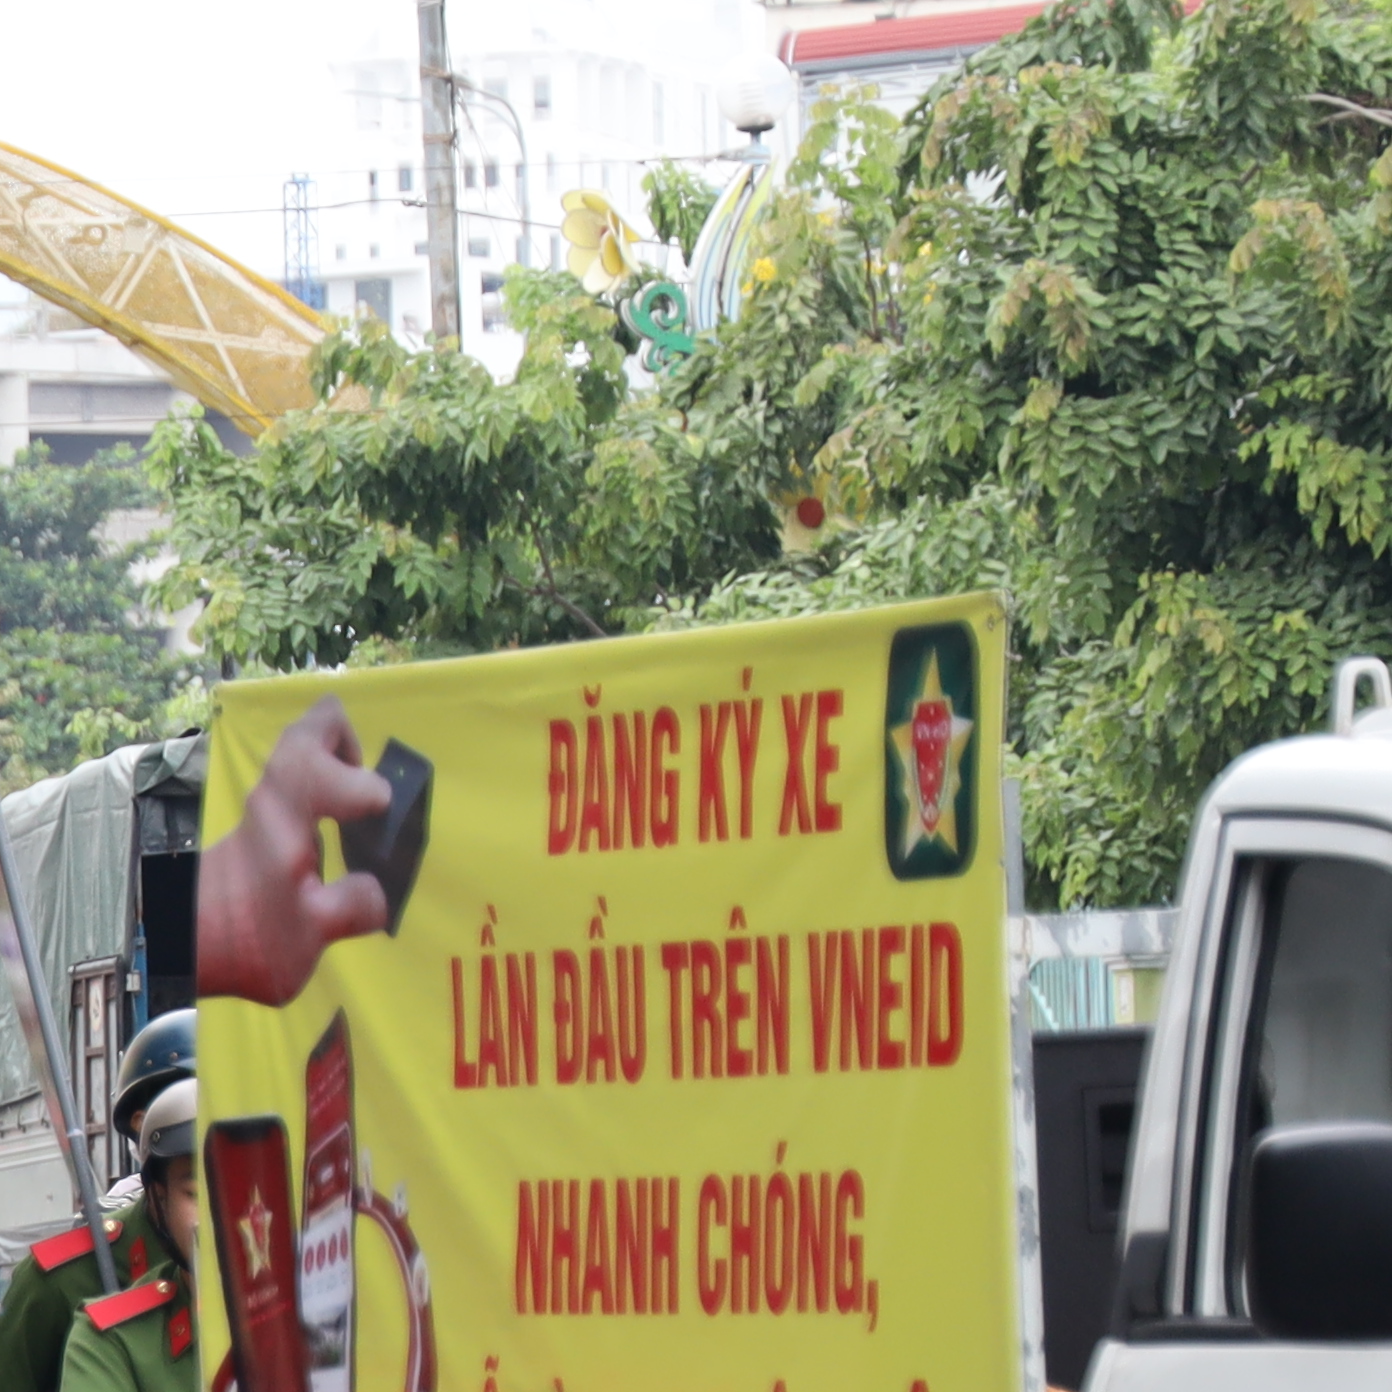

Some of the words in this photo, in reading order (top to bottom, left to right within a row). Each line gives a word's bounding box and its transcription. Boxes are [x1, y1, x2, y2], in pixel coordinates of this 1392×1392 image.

[547, 683, 681, 856] ĐĂNG
[698, 666, 764, 844] KÝ
[778, 688, 844, 837] XE
[451, 903, 539, 1090] LẦN
[552, 895, 646, 1086] ĐẦU
[661, 904, 791, 1080] TRÊN
[807, 921, 964, 1074] VNEID
[515, 1175, 680, 1316] NHANH
[697, 1140, 879, 1334] CHÓNG,
